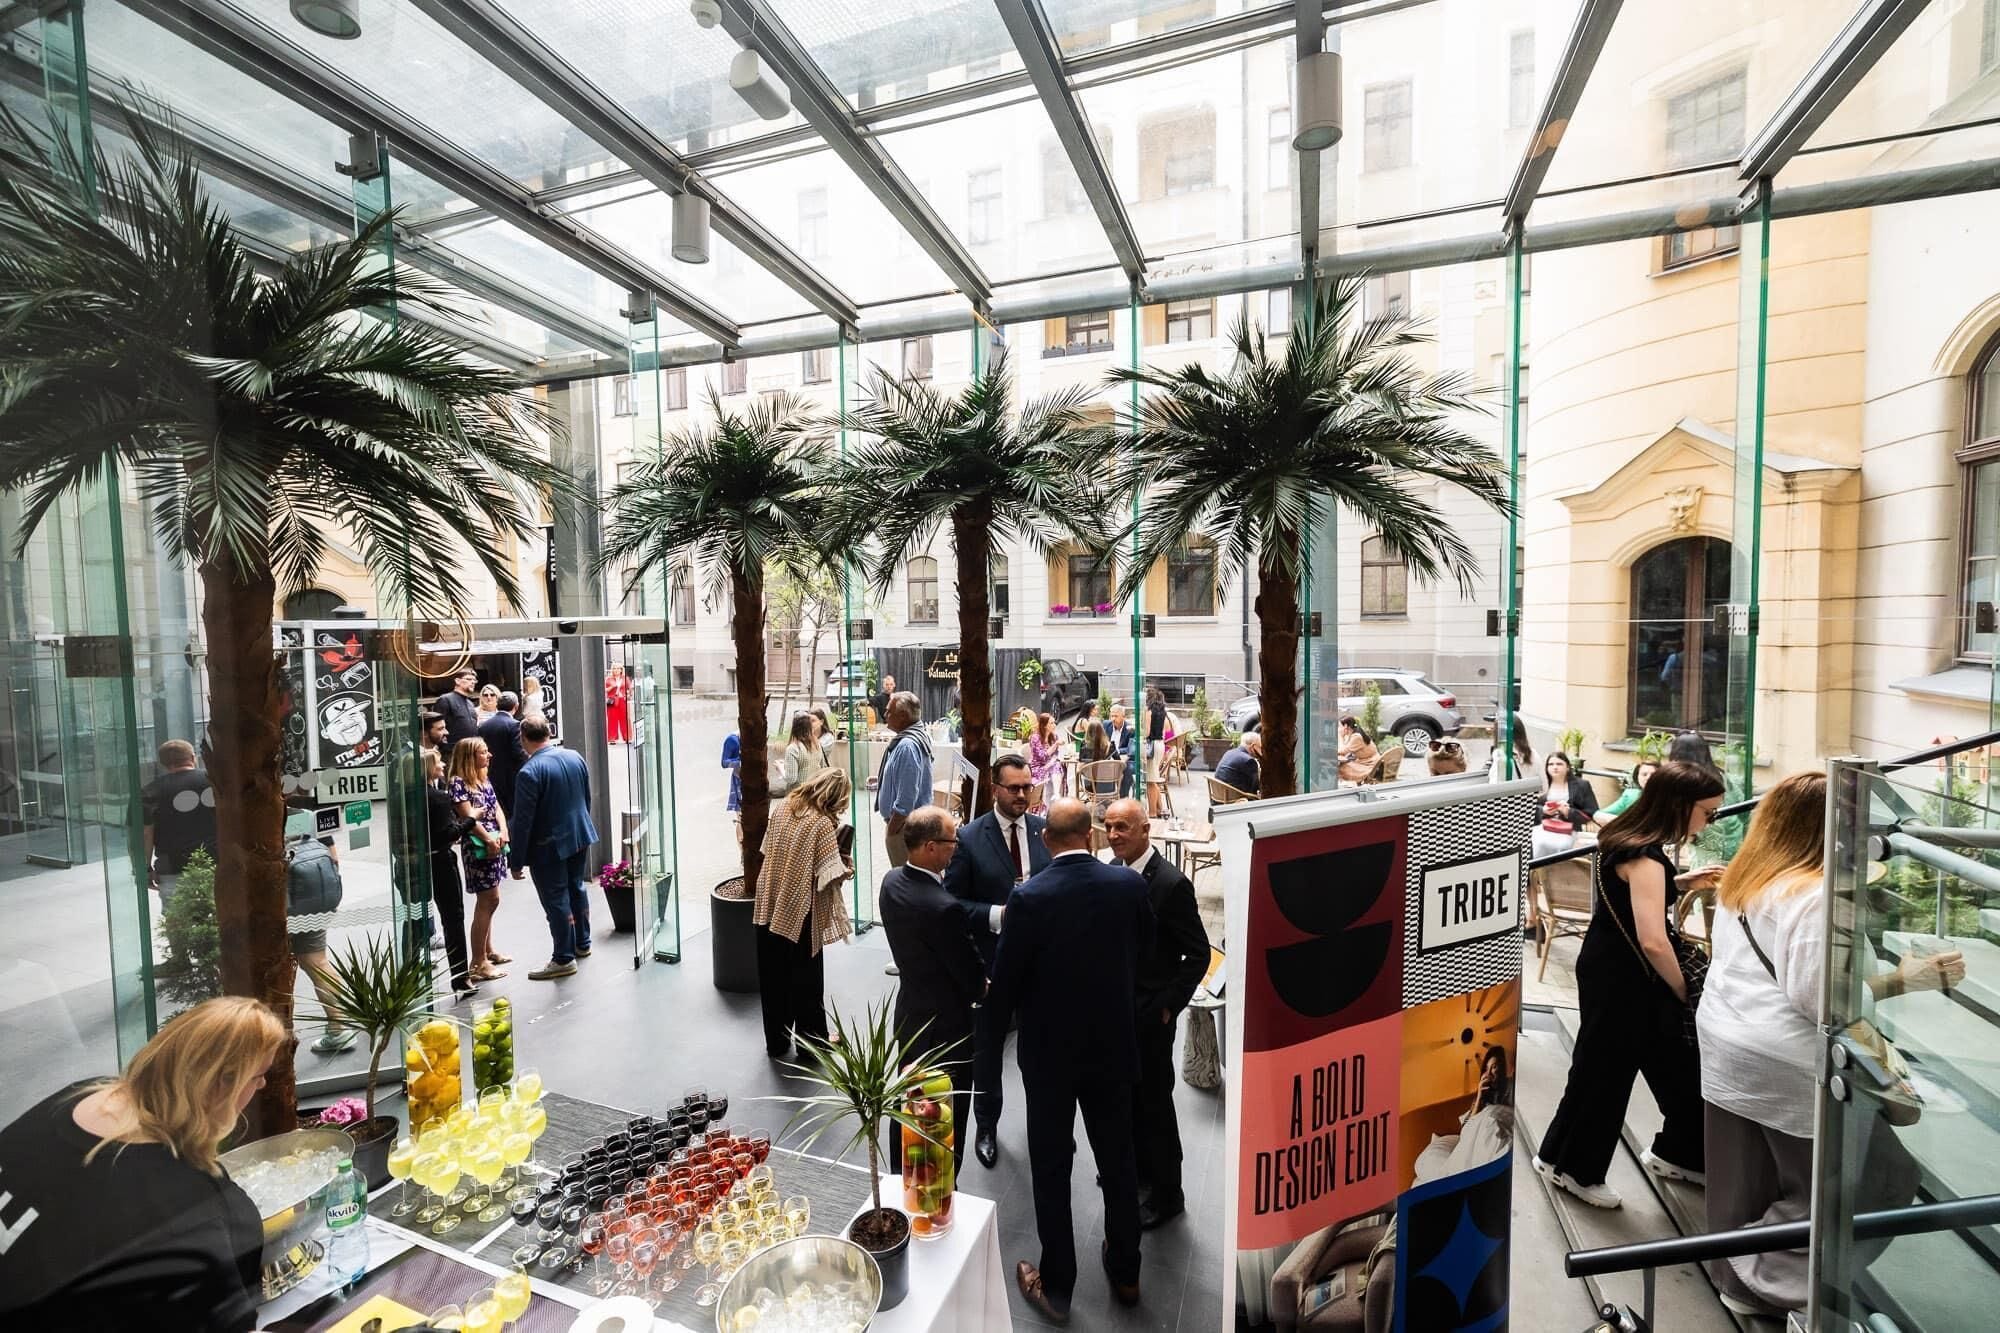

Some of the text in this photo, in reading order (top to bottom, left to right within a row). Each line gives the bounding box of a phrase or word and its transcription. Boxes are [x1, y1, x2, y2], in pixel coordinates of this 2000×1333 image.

[1438, 873, 1510, 928] TRIBE
[1290, 1054, 1366, 1140] A BOLD
[1254, 1110, 1391, 1216] DESIGN EDIT
